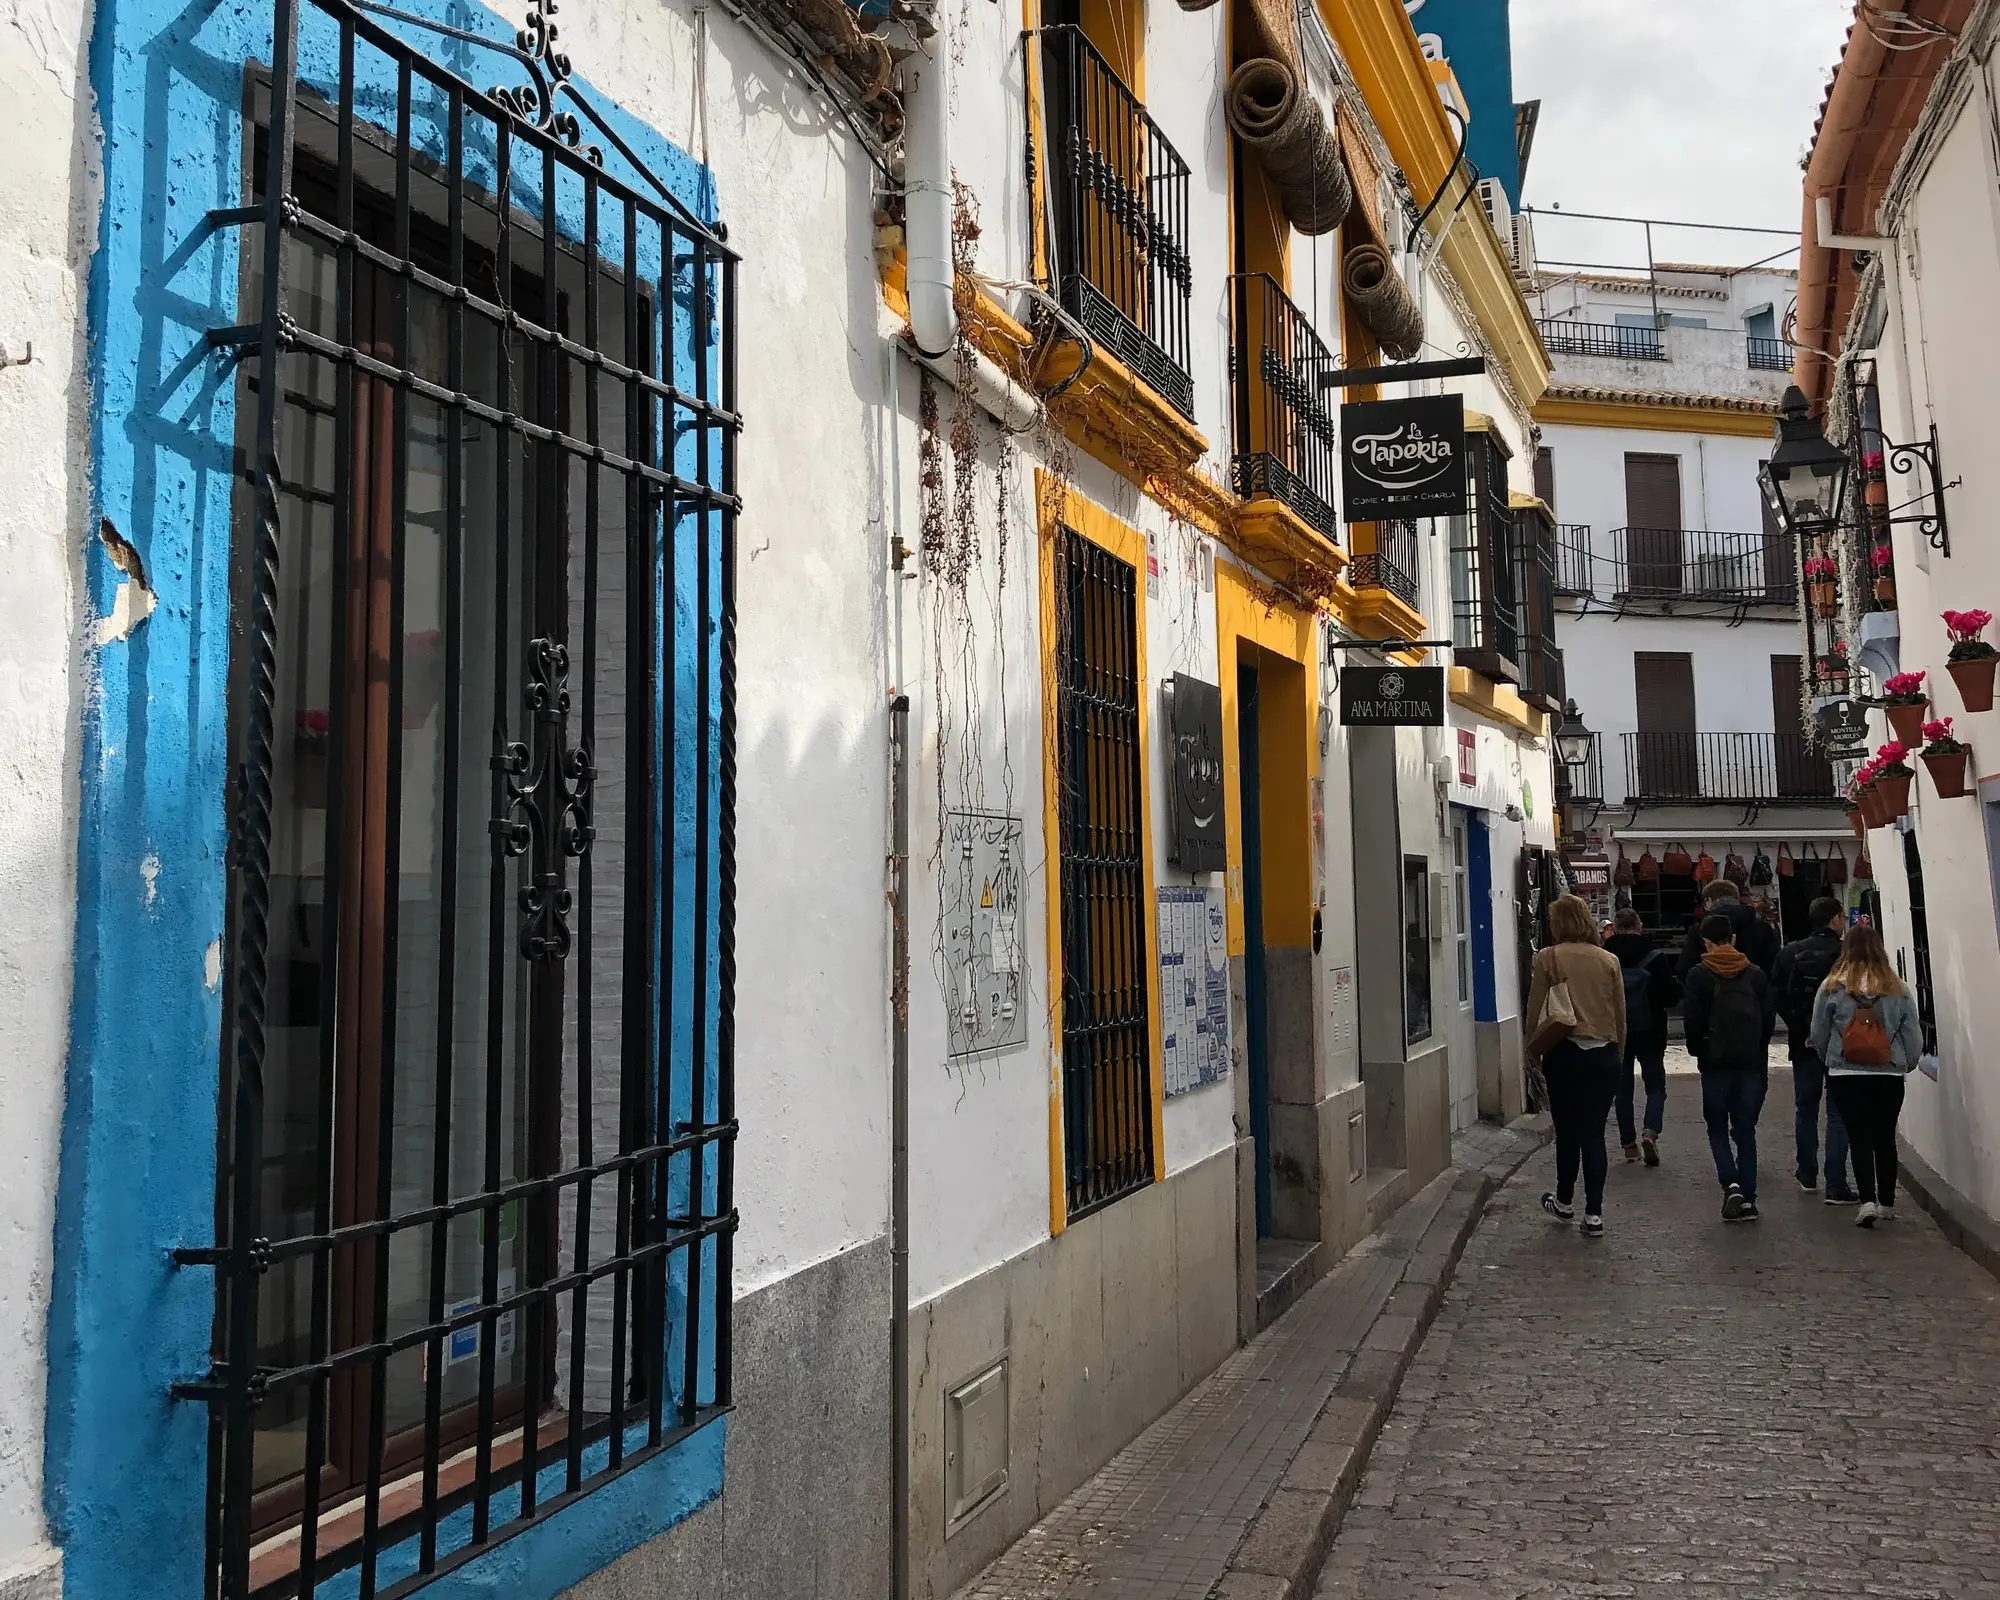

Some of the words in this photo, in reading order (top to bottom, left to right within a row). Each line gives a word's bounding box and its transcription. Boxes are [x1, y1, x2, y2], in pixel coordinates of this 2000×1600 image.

[1407, 422, 1424, 440] La
[1351, 425, 1454, 467] Tapería
[1352, 497, 1378, 505] COME
[1420, 491, 1456, 500] CHARLA
[1351, 700, 1373, 717] ANA
[1375, 700, 1433, 717] MARTINA
[1830, 726, 1862, 734] MONTILLA
